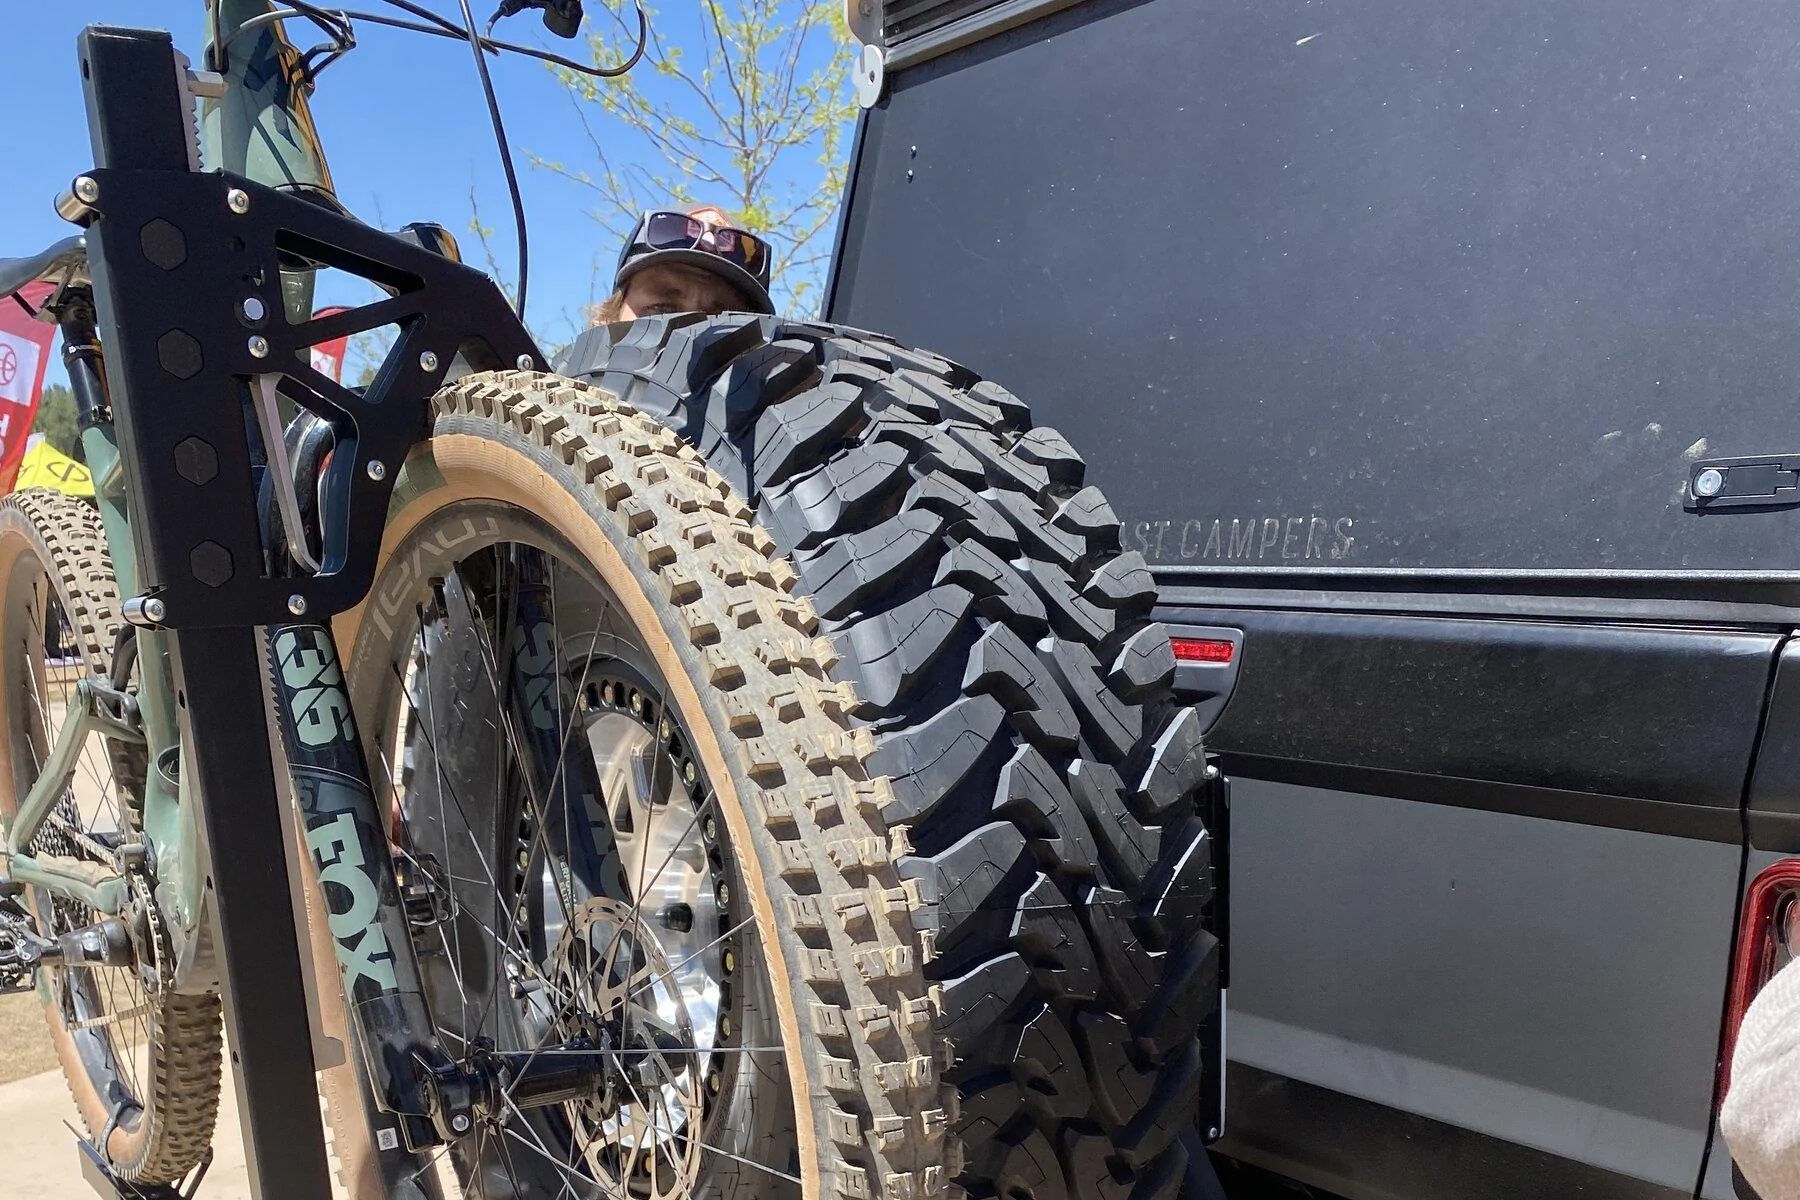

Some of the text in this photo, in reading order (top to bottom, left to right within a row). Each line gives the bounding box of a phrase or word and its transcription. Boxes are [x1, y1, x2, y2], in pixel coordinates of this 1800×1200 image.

[1180, 517, 1356, 559] CAMPERS
[275, 629, 355, 747] 36
[307, 812, 398, 1004] FOX
